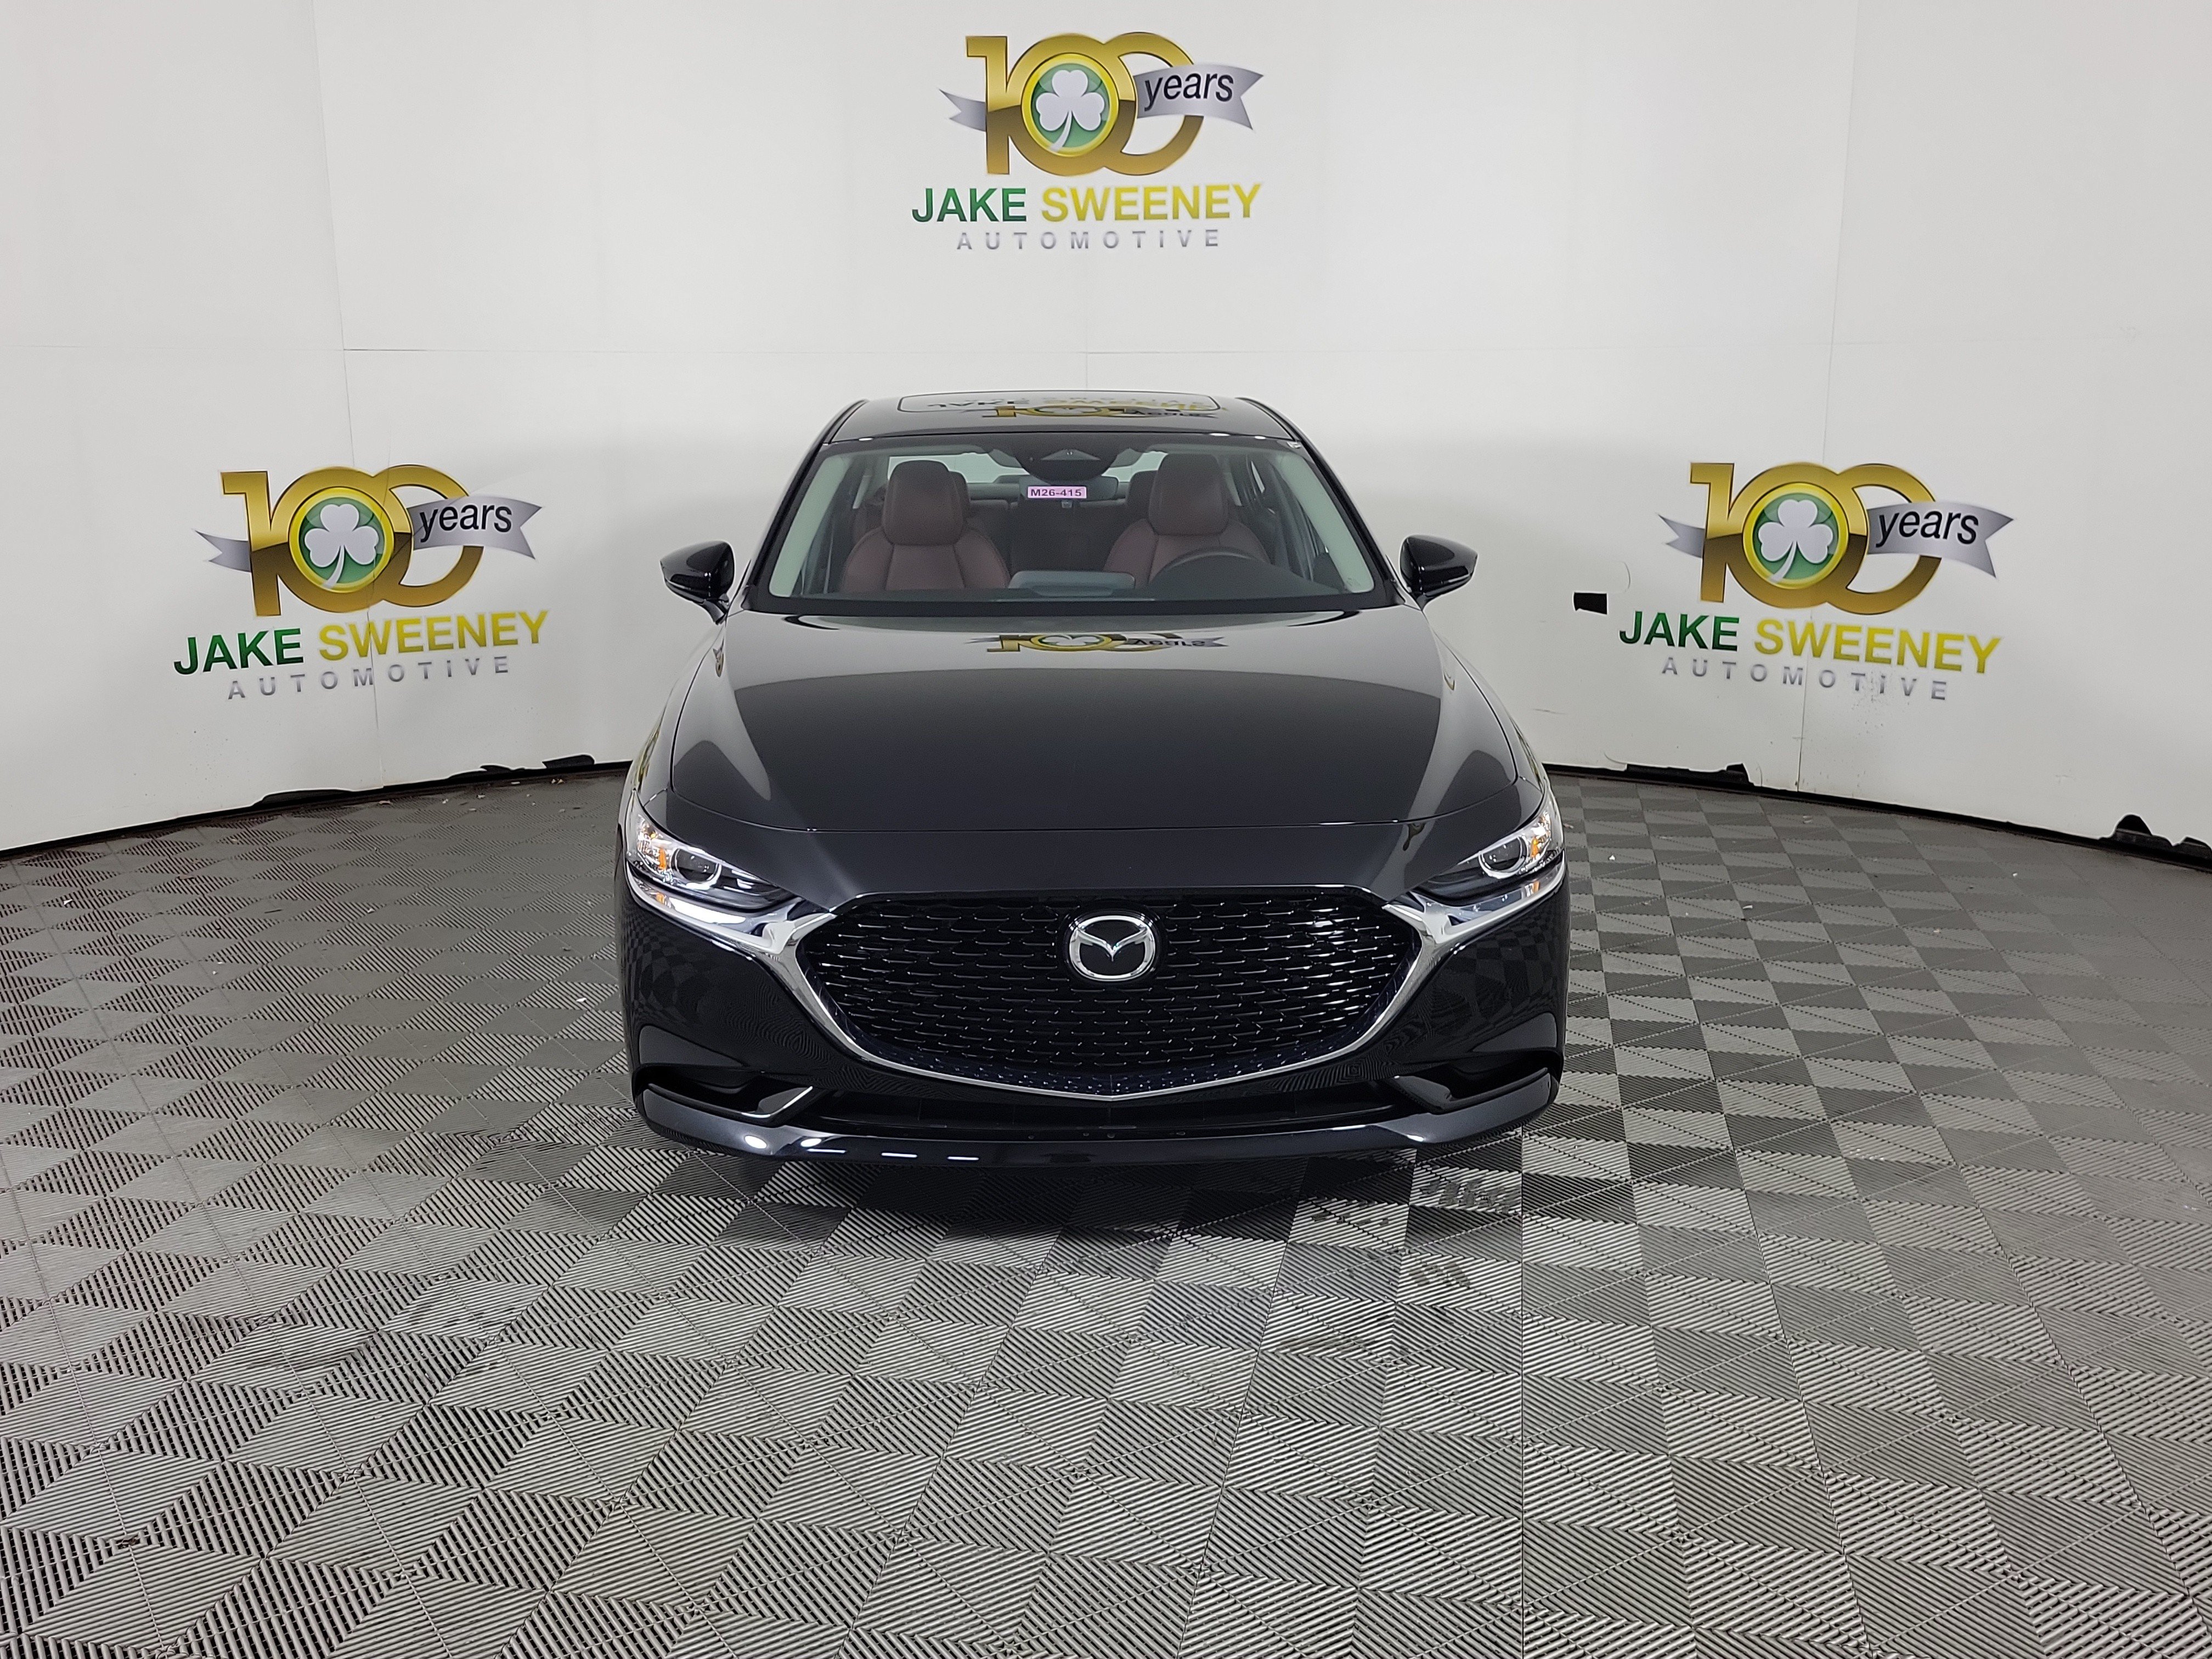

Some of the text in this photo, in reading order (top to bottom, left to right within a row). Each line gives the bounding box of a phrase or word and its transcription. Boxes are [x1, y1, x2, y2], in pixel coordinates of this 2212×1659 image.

[965, 31, 1234, 177] 100 years
[911, 183, 1262, 223] JAKE SWEENEY
[956, 229, 1219, 250] AUTOMOTIVE
[220, 464, 512, 617] 100 years
[1689, 461, 1979, 616] 100 years
[173, 609, 549, 675] JAKE SWEENEY
[1618, 610, 2001, 674] JAKE SWEENEY
[228, 656, 509, 700] AUTOMOTIVE
[1661, 656, 1948, 700] AUTOMOTIVE
